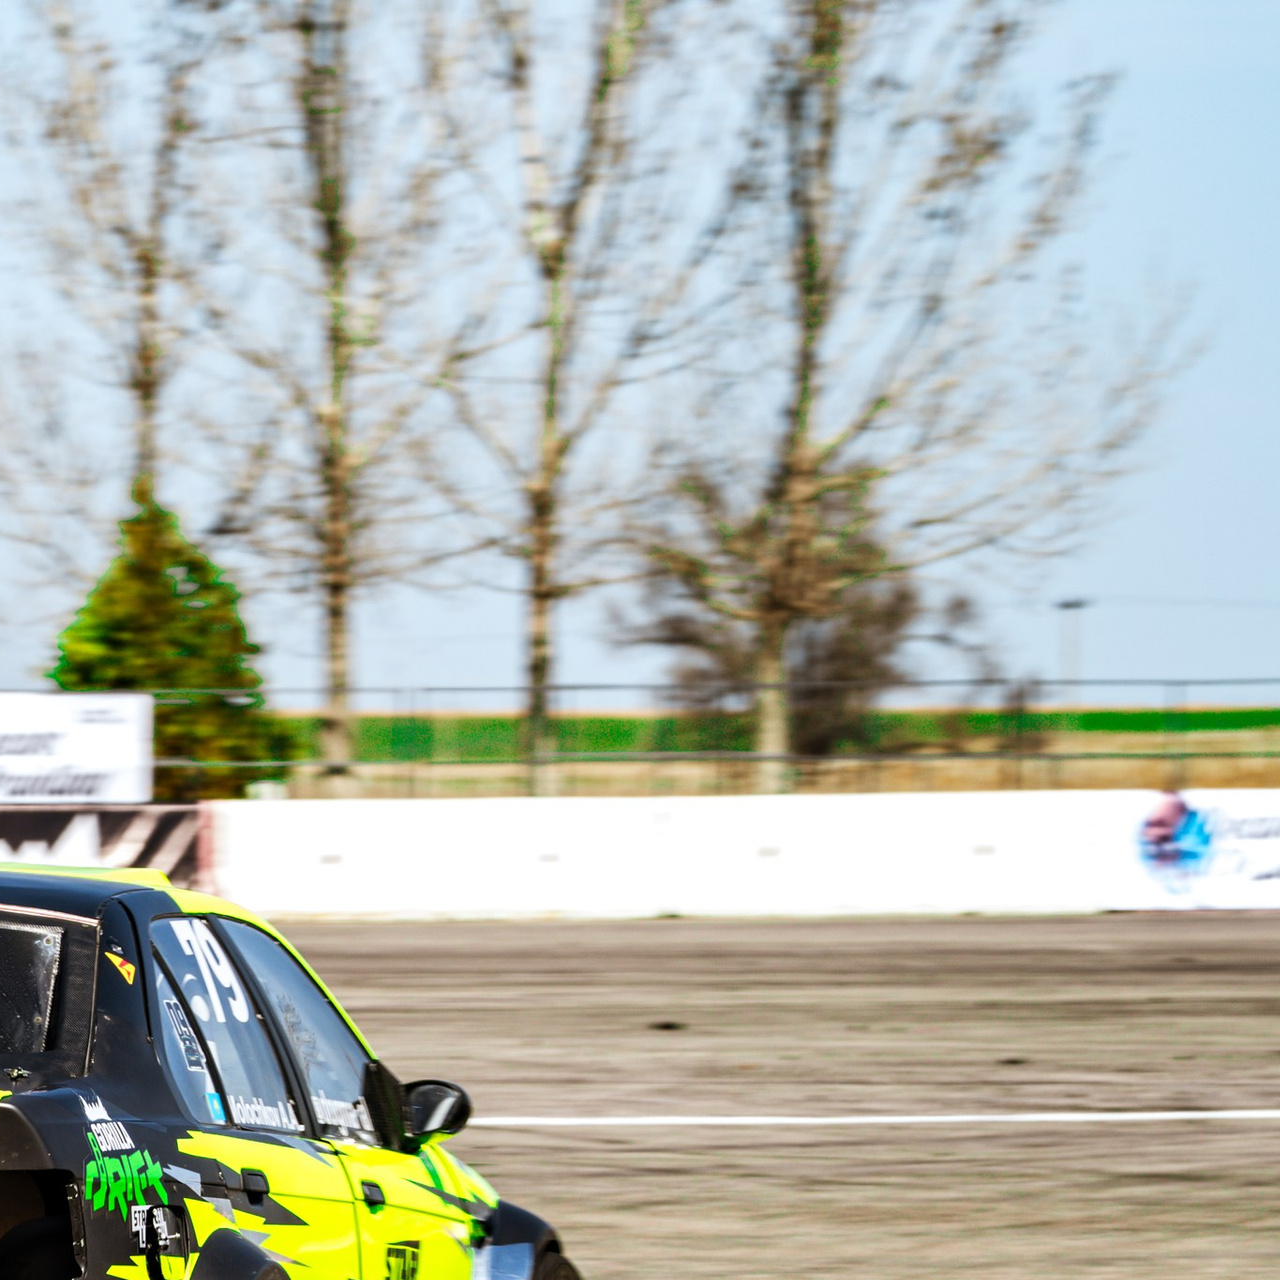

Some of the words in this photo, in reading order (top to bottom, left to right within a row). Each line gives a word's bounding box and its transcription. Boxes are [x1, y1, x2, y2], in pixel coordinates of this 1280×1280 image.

[170, 919, 250, 1023] 79
[84, 1132, 169, 1223] DRIFT
[91, 1121, 135, 1152] GORILLA
